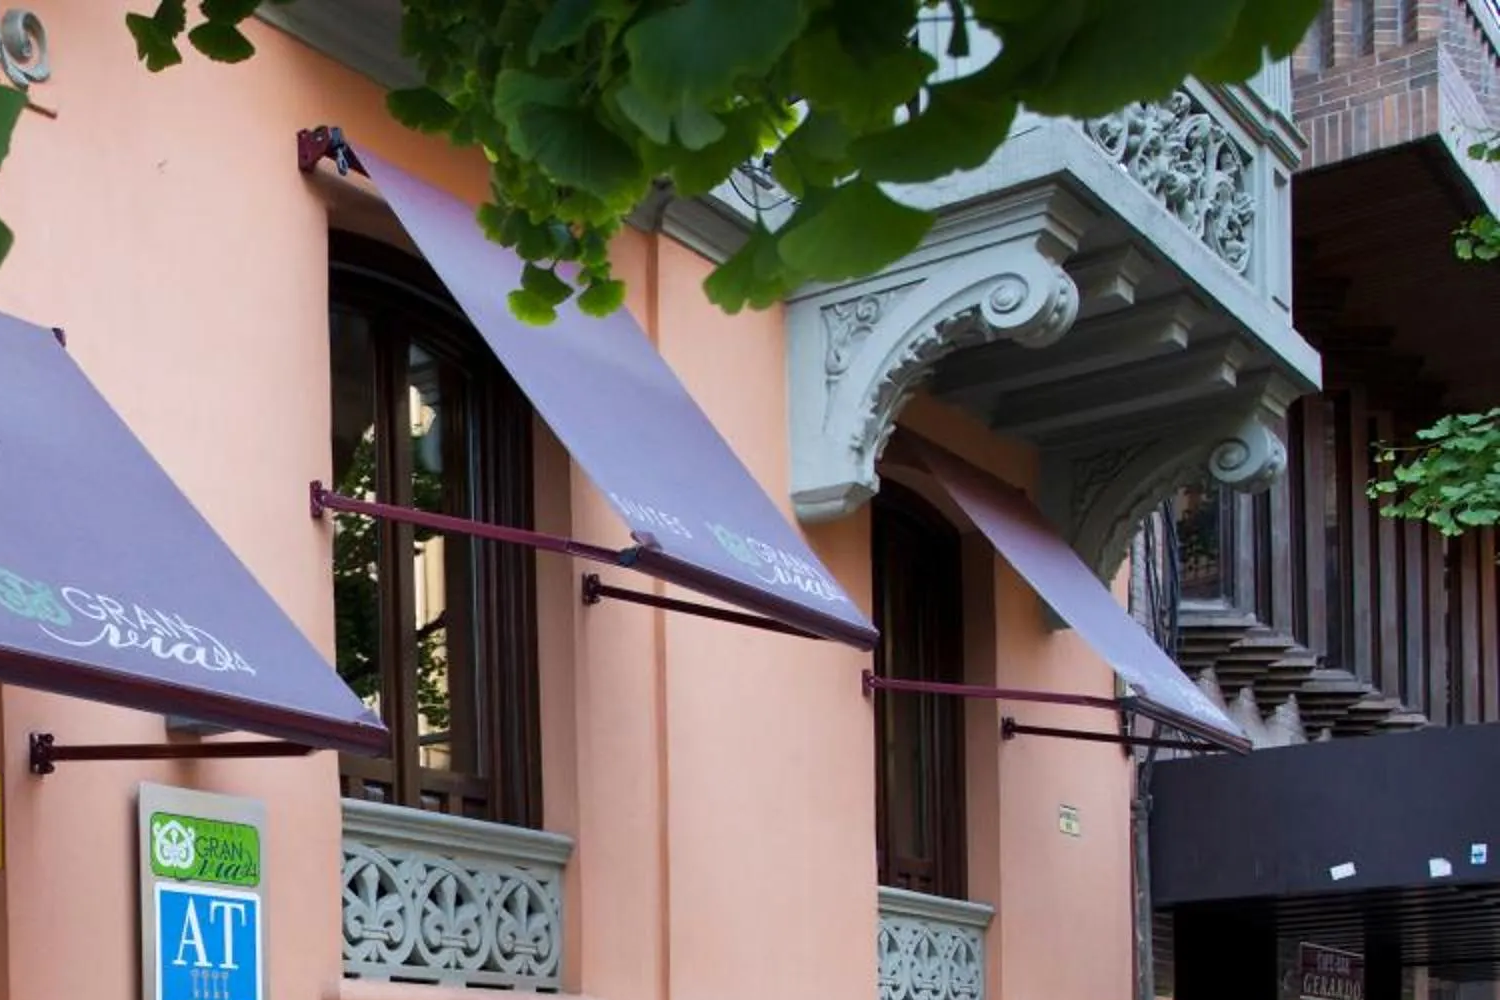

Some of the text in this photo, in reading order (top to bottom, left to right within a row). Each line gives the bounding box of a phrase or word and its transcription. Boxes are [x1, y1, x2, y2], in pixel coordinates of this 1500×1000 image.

[60, 586, 201, 641] GRAN
[194, 835, 243, 862] GRAN
[172, 896, 247, 971] AT
